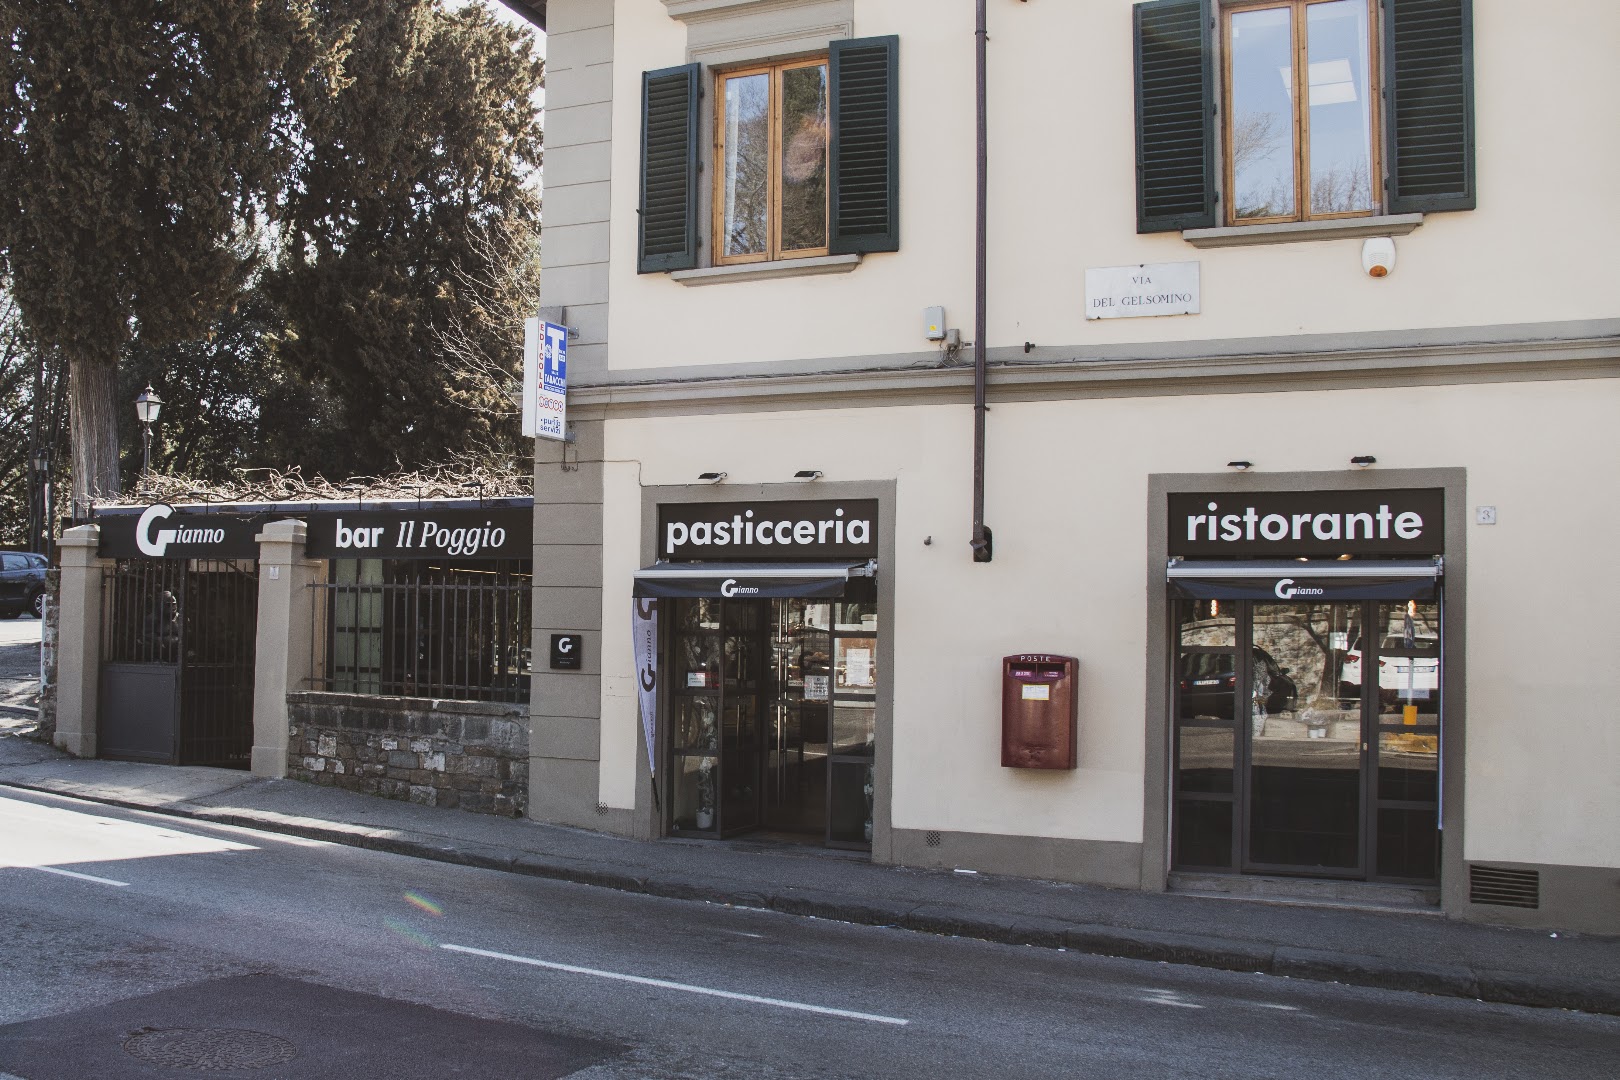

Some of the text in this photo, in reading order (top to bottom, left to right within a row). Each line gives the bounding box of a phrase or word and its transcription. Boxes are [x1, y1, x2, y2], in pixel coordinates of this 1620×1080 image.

[1132, 276, 1152, 285] VIA
[1093, 293, 1192, 308] DEL GELSOMINO
[547, 326, 564, 371] T
[540, 424, 561, 435] servizi
[136, 503, 225, 557] Gianno
[667, 508, 870, 554] pasticceria
[1187, 502, 1423, 542] ristorante
[336, 519, 506, 556] bar Il Poggio
[721, 579, 759, 598] Gianno
[1275, 579, 1324, 599] Gianno
